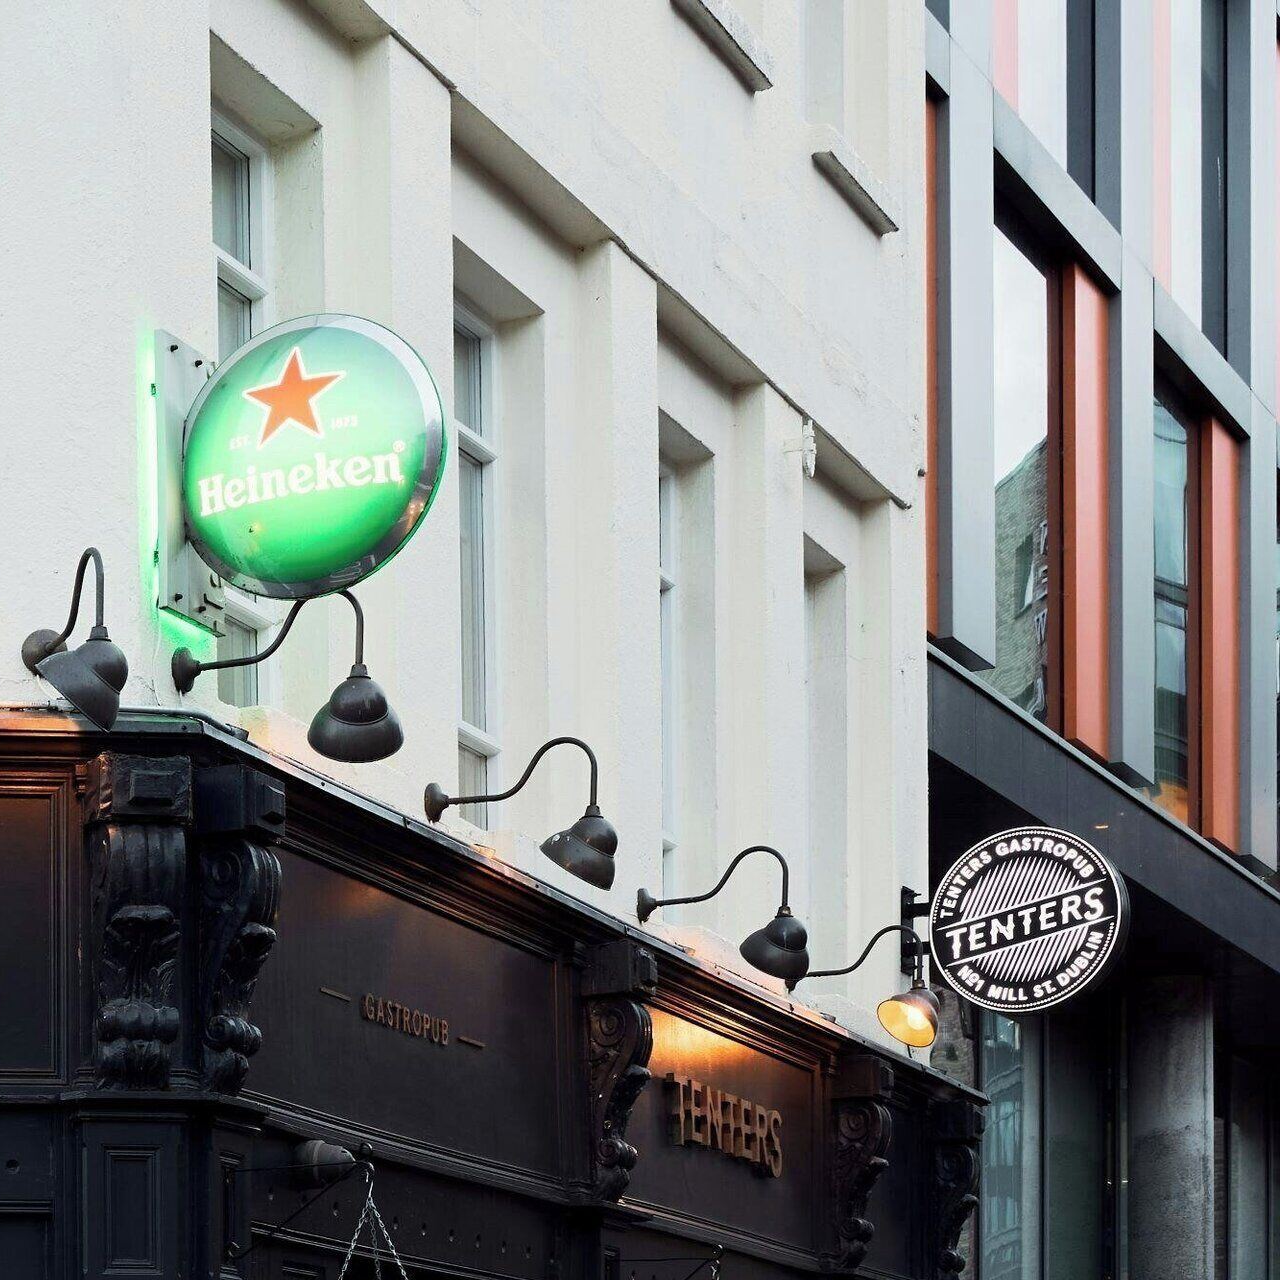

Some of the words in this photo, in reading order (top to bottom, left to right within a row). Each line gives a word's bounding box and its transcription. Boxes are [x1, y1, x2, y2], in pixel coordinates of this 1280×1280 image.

[940, 850, 992, 919] TENTERS
[995, 837, 1094, 878] GASTROPUB
[945, 887, 1104, 959] TENTERS
[987, 984, 1028, 1001] MILL
[1033, 979, 1056, 998] ST.
[1056, 931, 1104, 987] DUBLIN
[364, 992, 449, 1046] GASTROPUB
[666, 1072, 783, 1178] TENTERS
